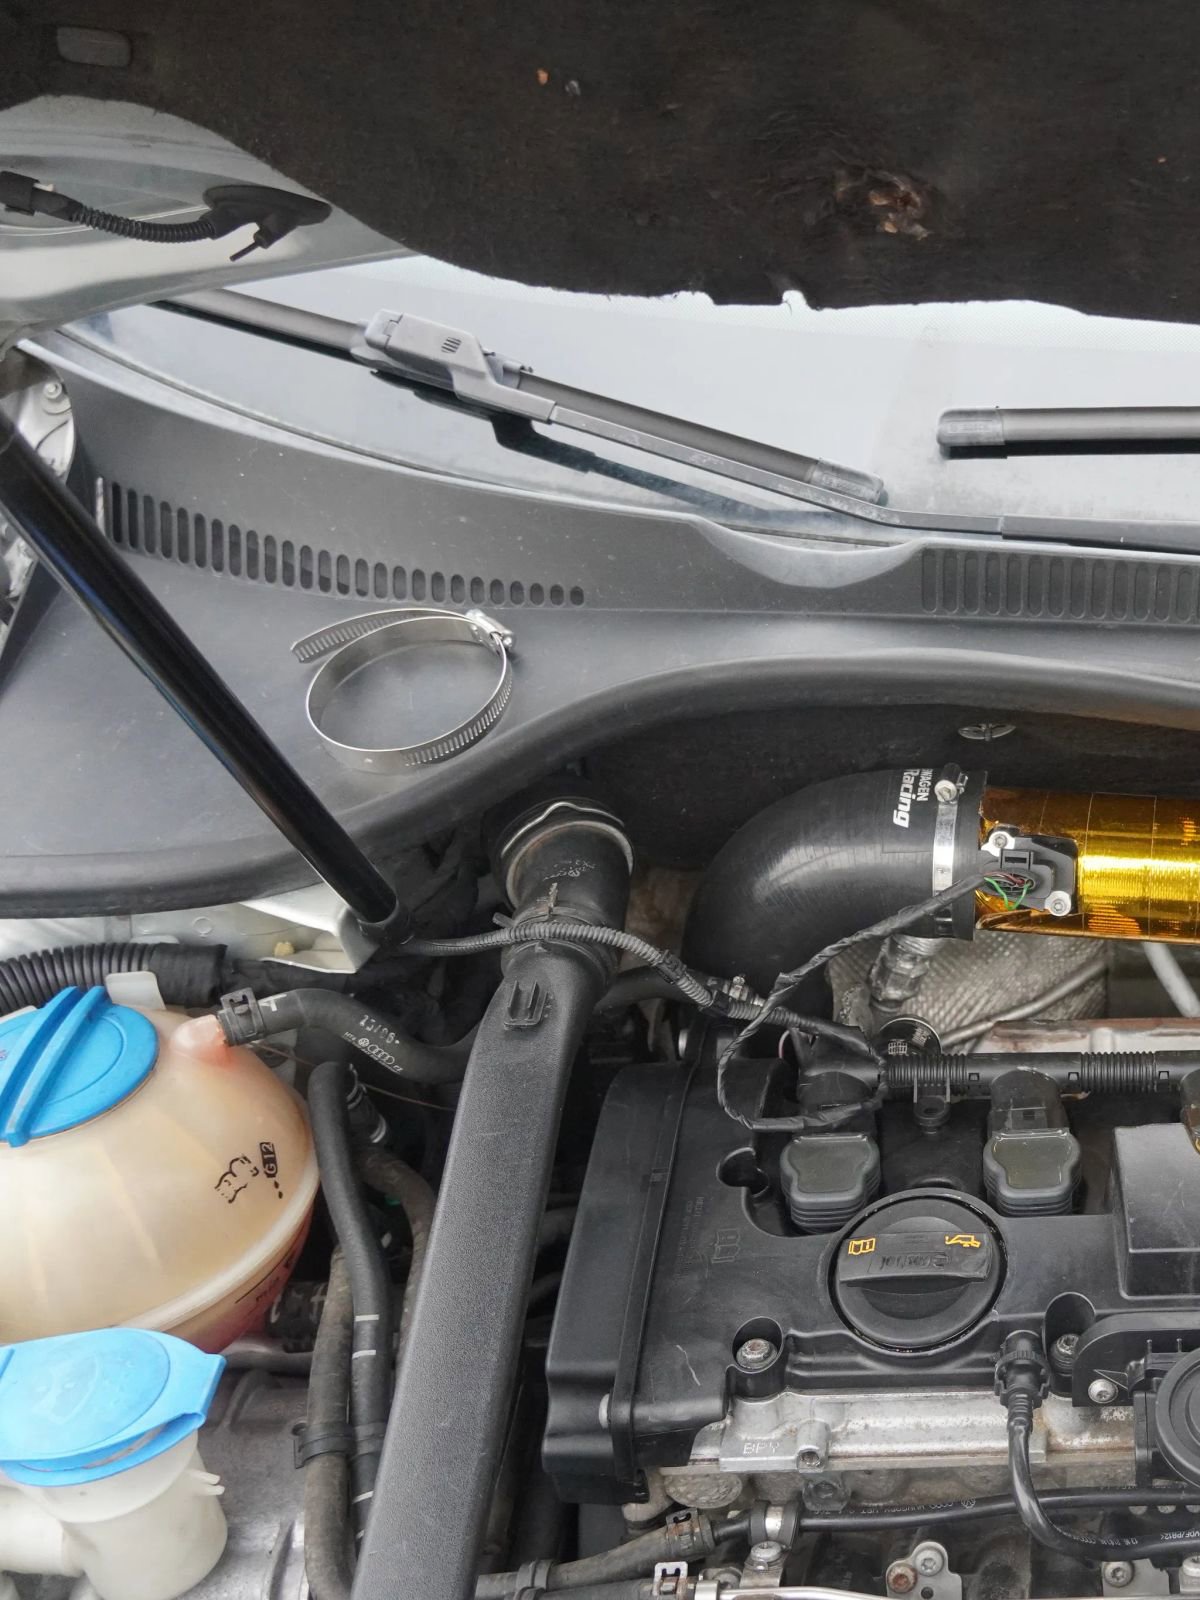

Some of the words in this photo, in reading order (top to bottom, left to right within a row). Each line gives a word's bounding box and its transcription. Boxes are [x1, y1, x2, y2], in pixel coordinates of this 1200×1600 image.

[893, 769, 921, 828] Racing
[917, 768, 934, 801] WAGEN
[261, 1142, 277, 1175] G12
